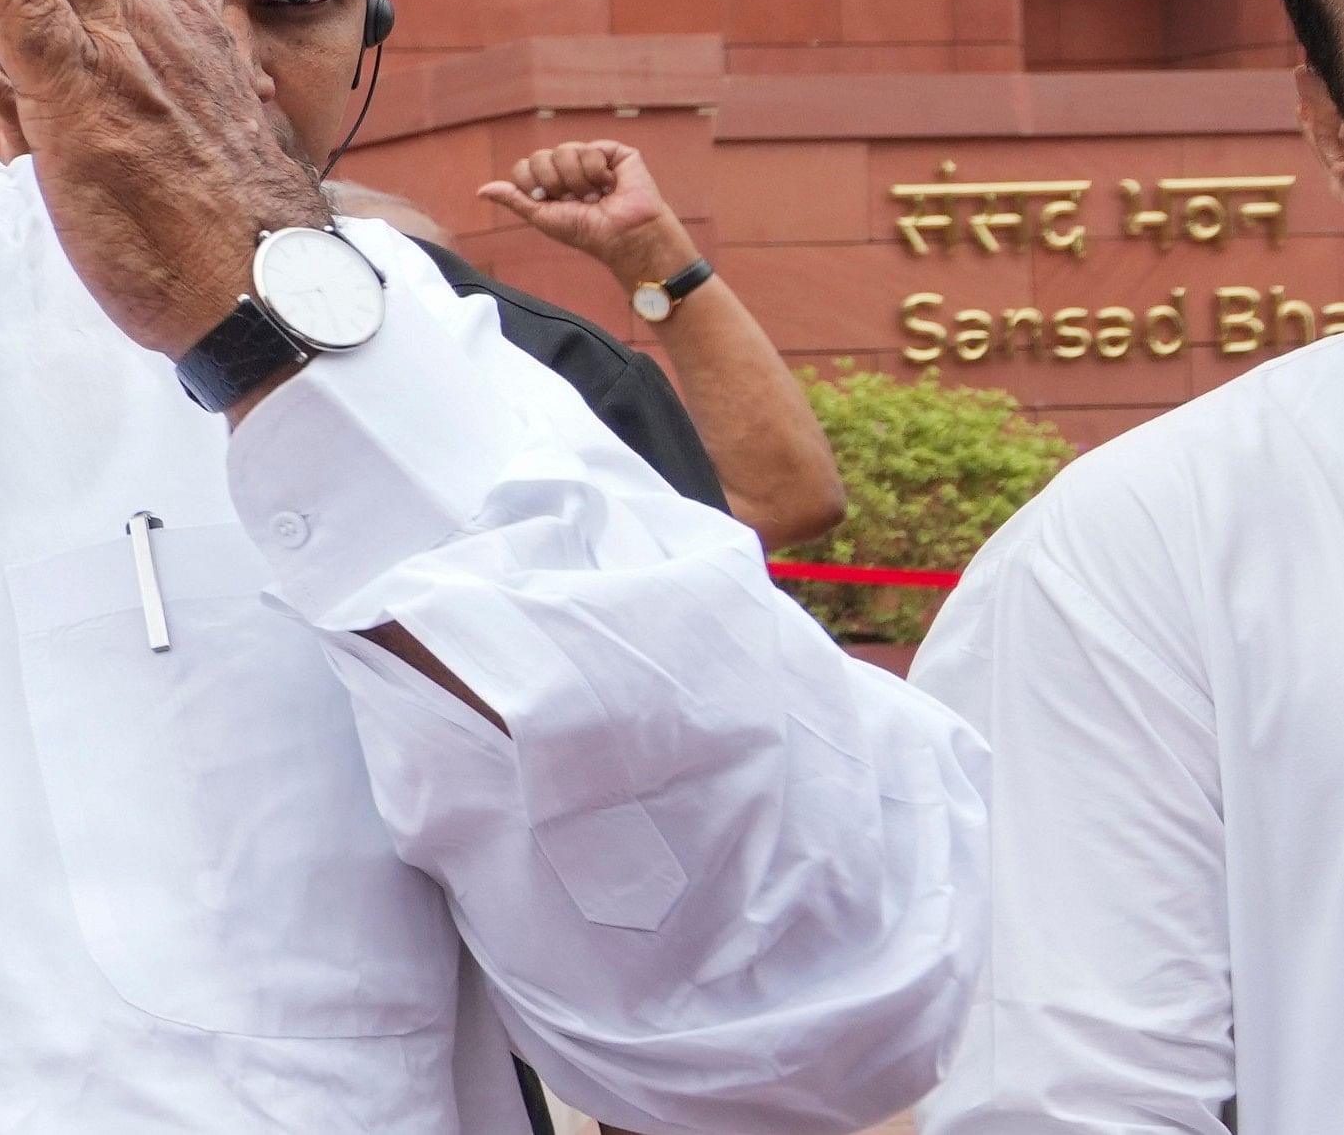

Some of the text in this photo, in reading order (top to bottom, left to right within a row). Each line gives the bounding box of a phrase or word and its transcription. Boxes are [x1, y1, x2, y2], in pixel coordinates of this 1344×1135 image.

[890, 158, 1298, 259] संसद भवन
[901, 285, 1188, 363] Sansad
